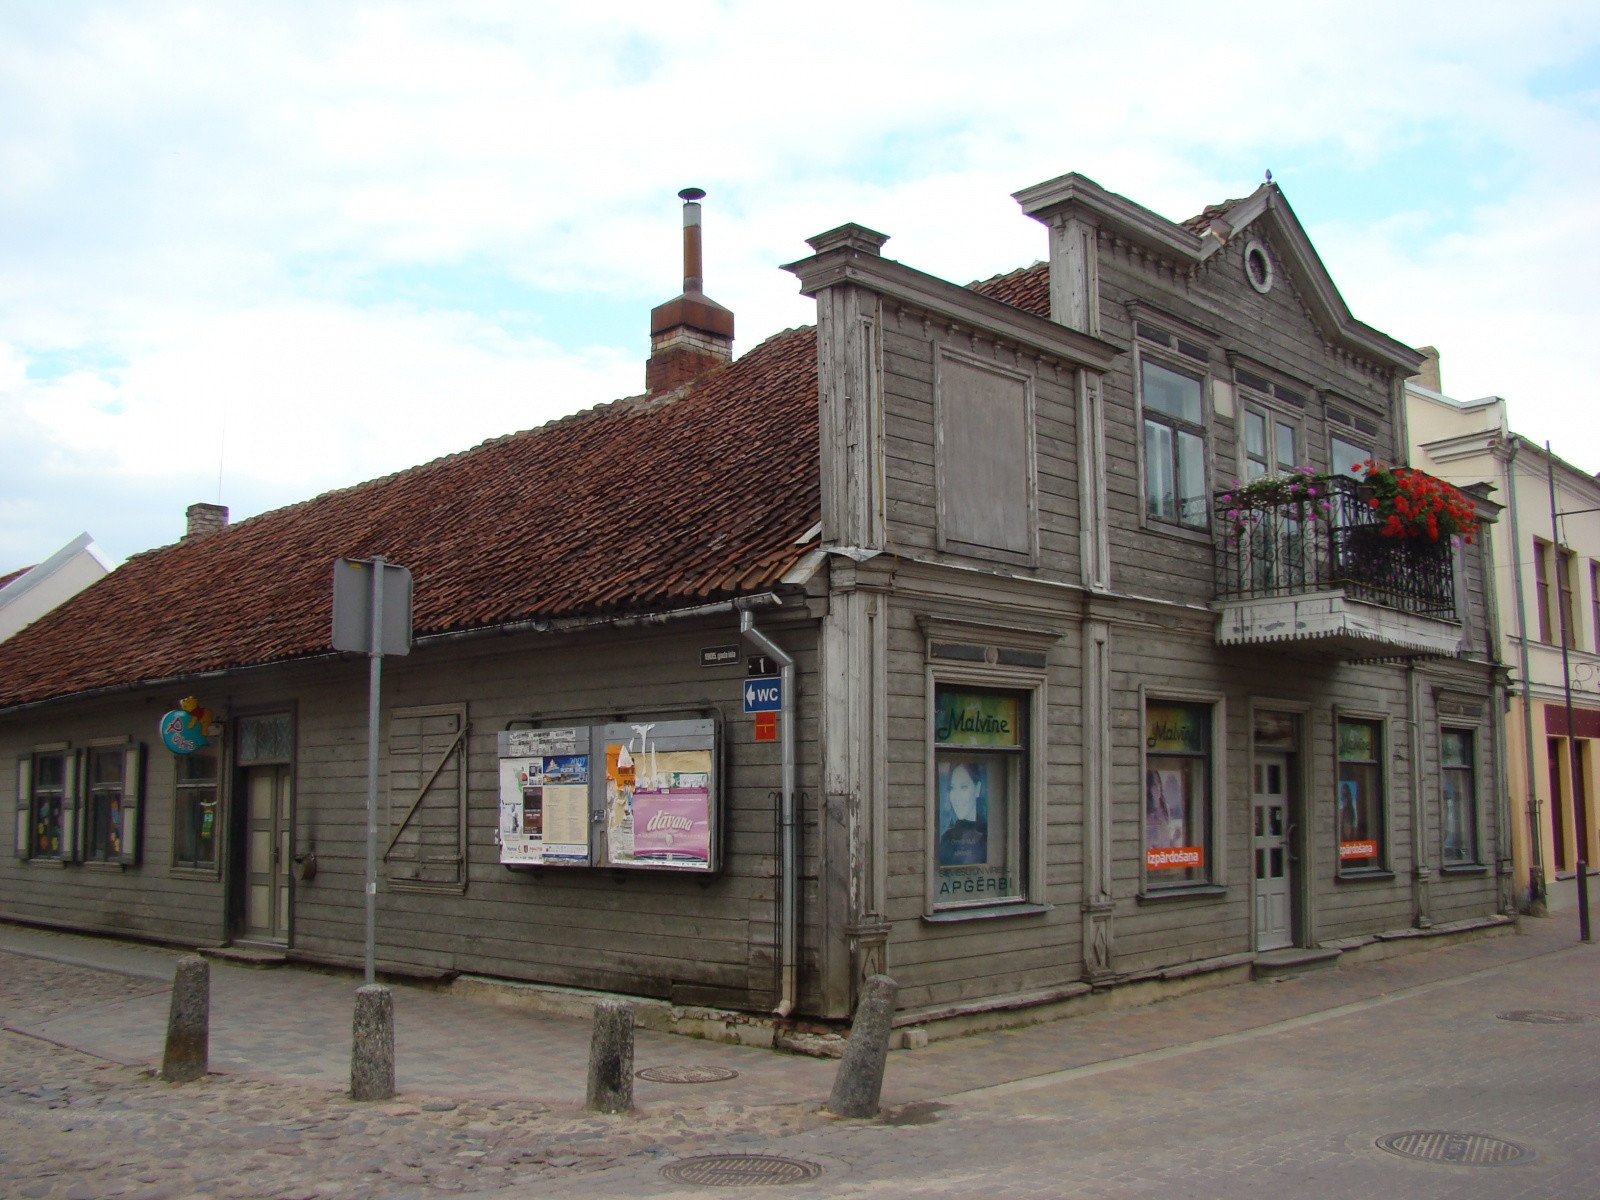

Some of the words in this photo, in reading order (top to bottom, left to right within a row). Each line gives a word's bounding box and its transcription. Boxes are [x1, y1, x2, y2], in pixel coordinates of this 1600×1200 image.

[757, 687, 778, 702] WC
[937, 707, 1010, 741] Malvīne
[646, 809, 694, 832] dāvana
[1147, 850, 1199, 867] izpārdošana
[939, 876, 1012, 894] APĢĒRBI
